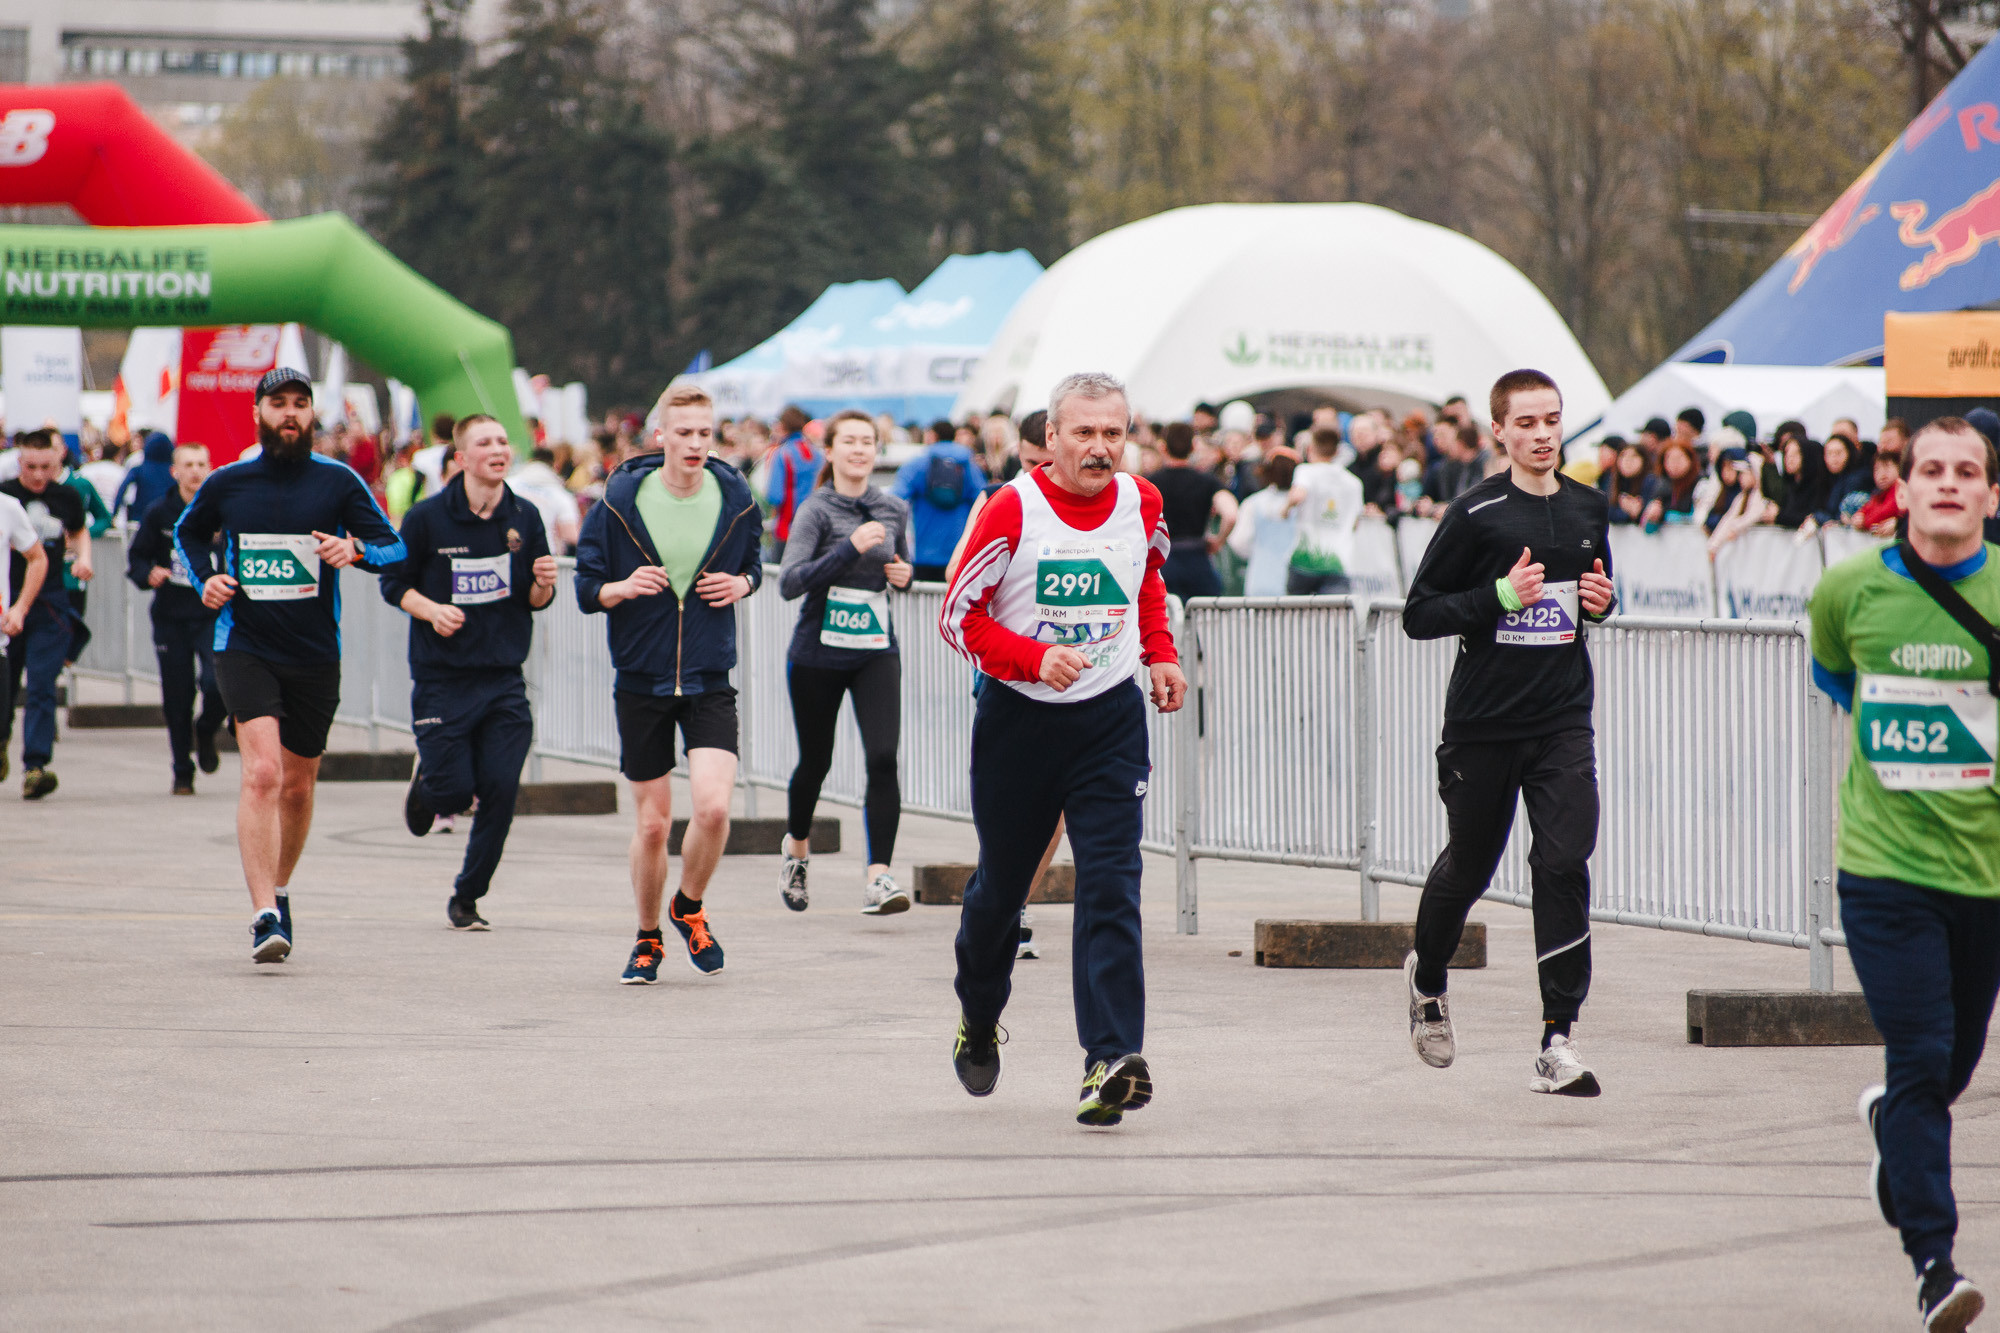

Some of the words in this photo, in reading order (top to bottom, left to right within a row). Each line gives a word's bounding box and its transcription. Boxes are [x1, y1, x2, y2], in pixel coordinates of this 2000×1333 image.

[5, 247, 208, 270] HERBALIFE
[6, 271, 211, 298] NUTRITION
[1267, 331, 1431, 350] HERBALIFE
[1268, 350, 1434, 371] NUTRITION
[1055, 547, 1095, 555] Жилстрой-1
[242, 558, 295, 579] 3245
[457, 574, 499, 592] 5109
[1043, 572, 1101, 597] 2991
[829, 609, 871, 630] 1068
[1040, 608, 1050, 616] 10
[1052, 609, 1067, 618] KM
[1505, 606, 1561, 628] 5425
[1501, 633, 1510, 641] 10
[1512, 634, 1525, 642] KM
[1870, 719, 1949, 753] 1452
